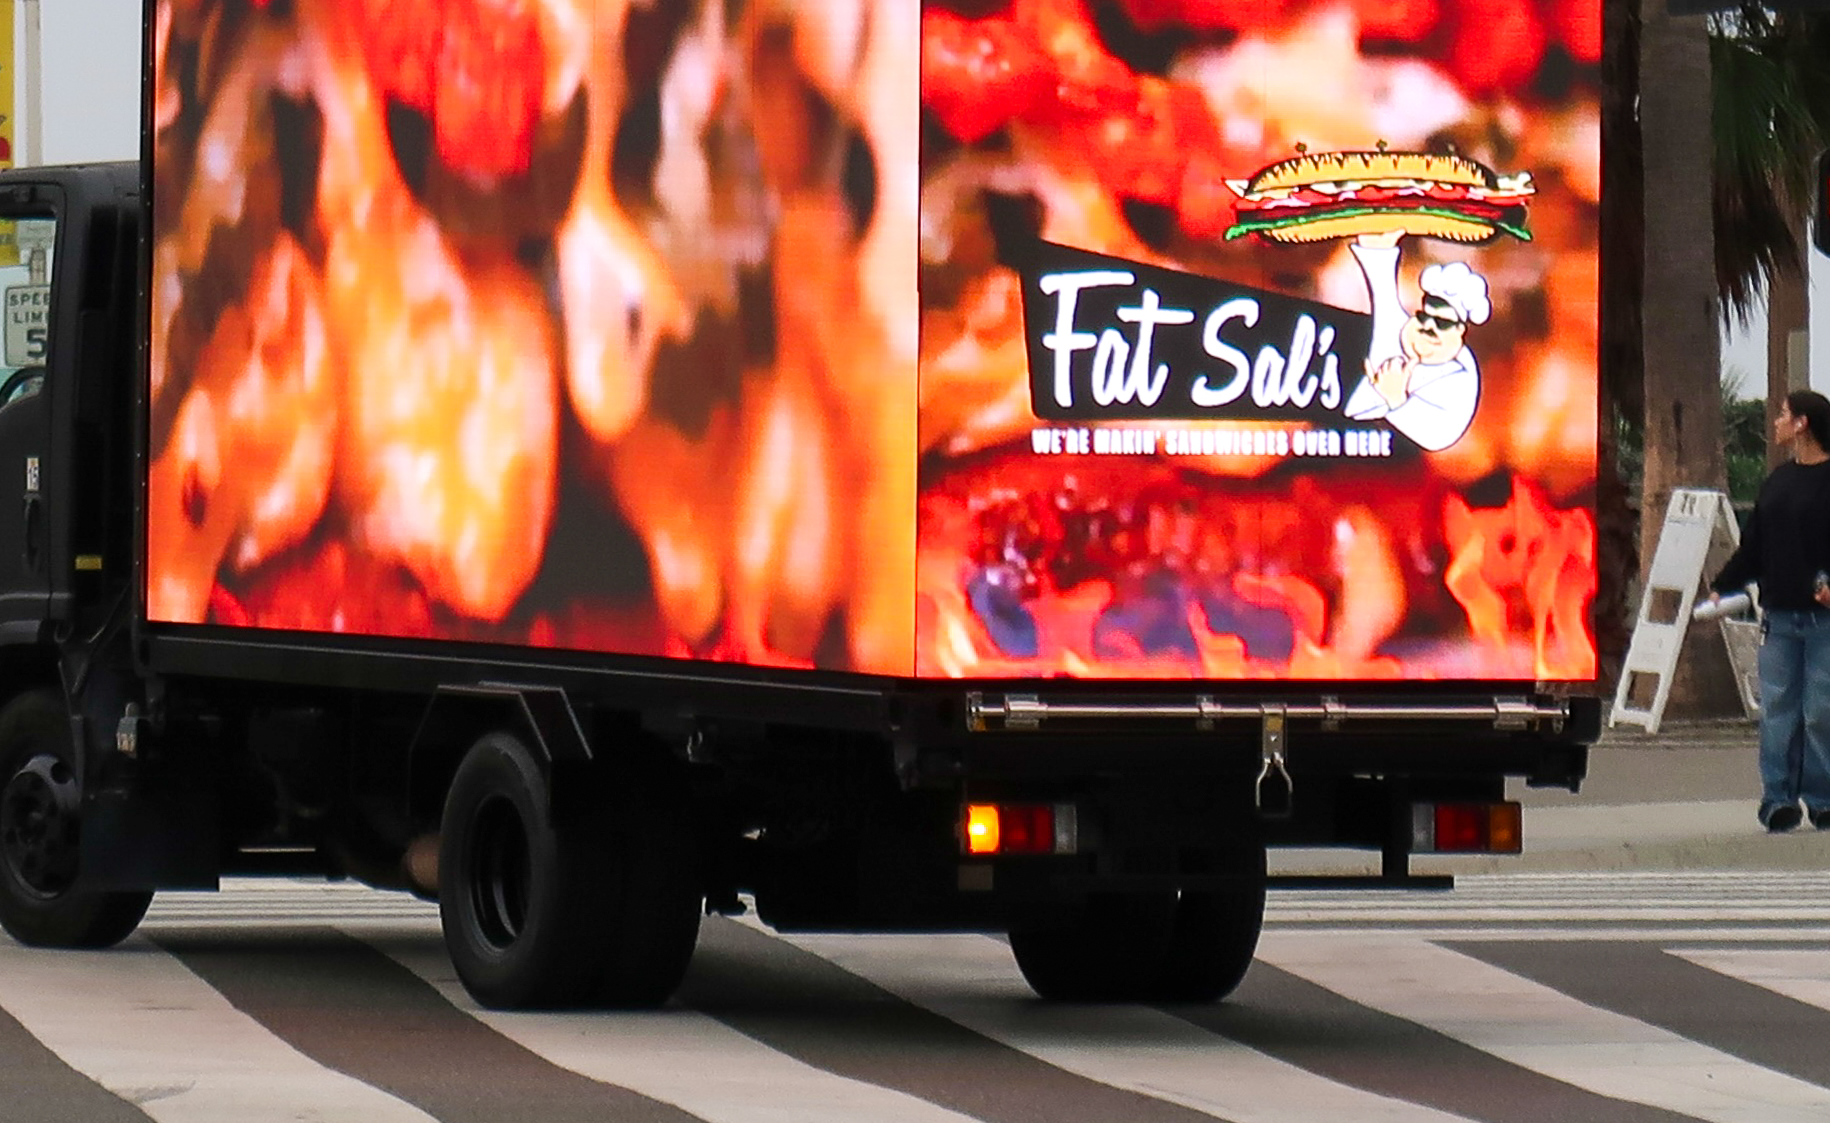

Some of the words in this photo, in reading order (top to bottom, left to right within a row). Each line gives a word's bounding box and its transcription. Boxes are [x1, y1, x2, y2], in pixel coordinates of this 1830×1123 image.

[10, 293, 50, 306] SPEE
[14, 312, 50, 323] LIMI
[1040, 272, 1195, 407] Fat
[1191, 298, 1341, 409] Sal's
[1032, 428, 1090, 454] WE'RE
[1093, 428, 1162, 455] MAKIN'
[1165, 429, 1289, 455] SANDWICHES
[1293, 429, 1341, 456] OVER
